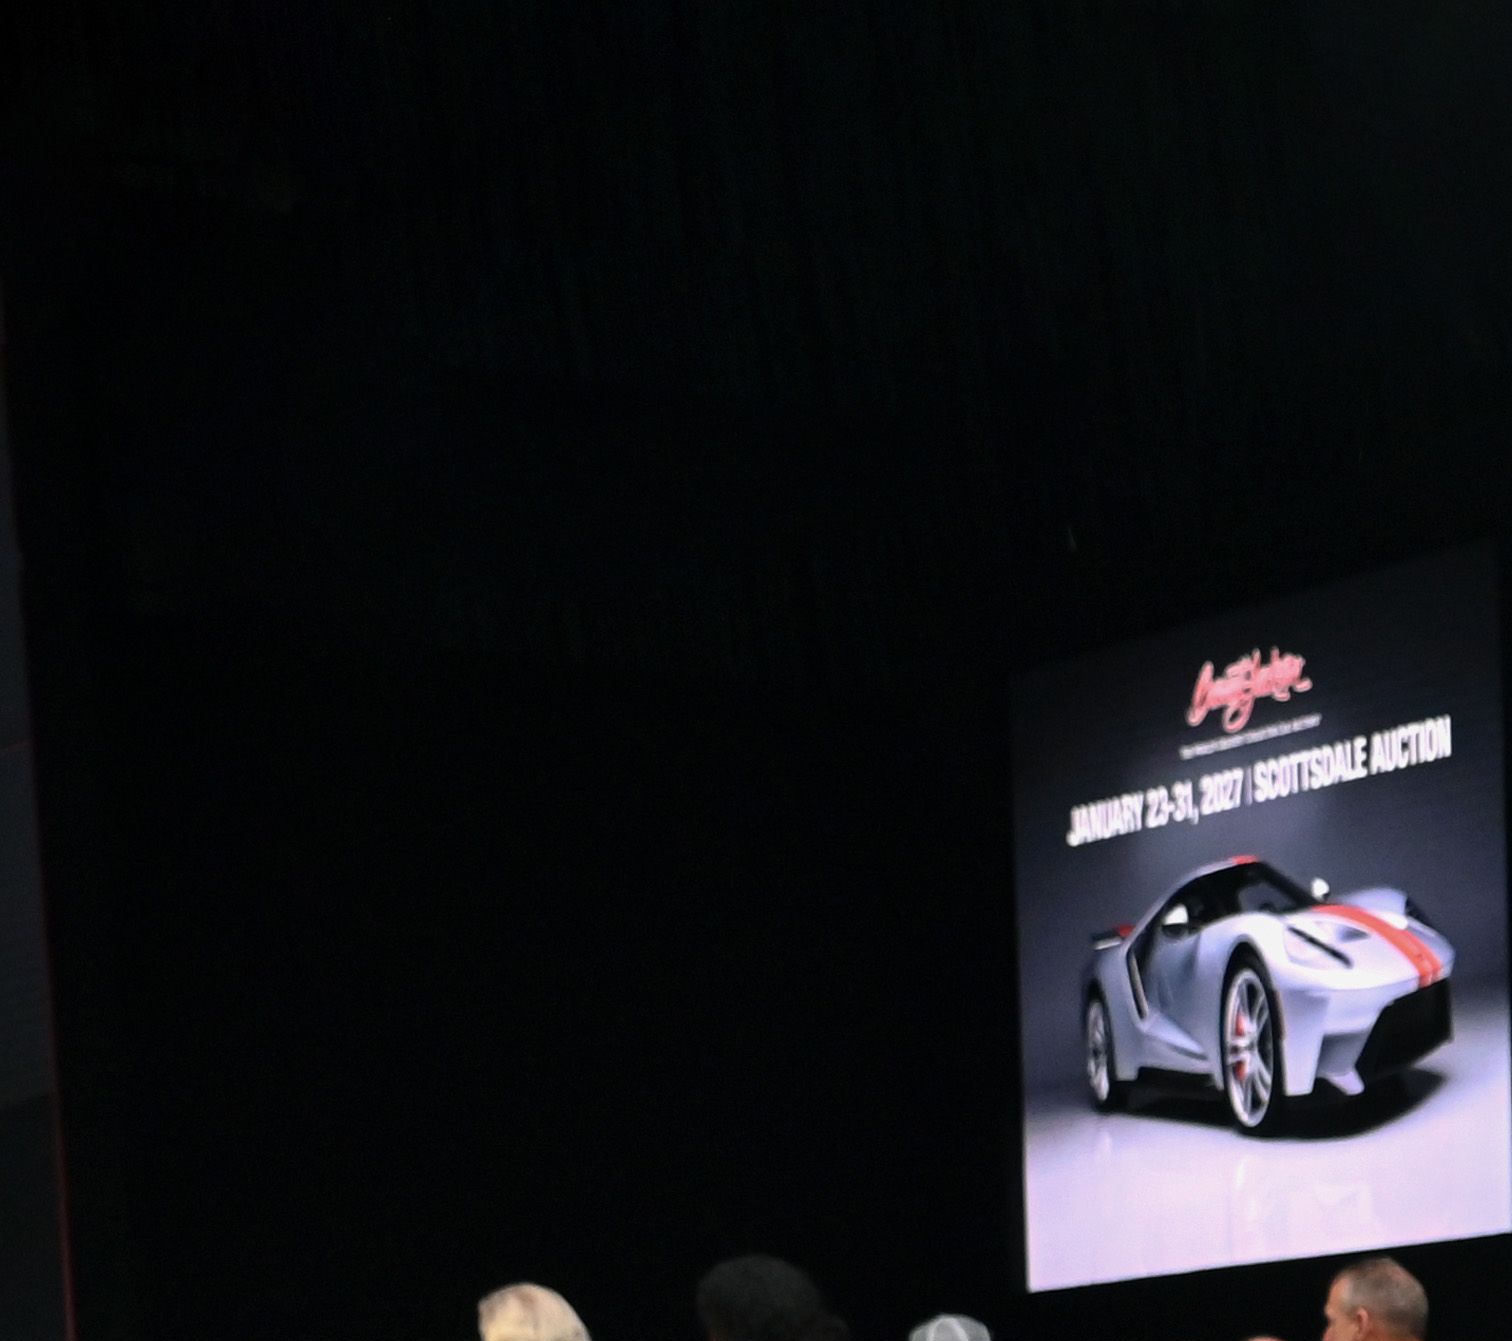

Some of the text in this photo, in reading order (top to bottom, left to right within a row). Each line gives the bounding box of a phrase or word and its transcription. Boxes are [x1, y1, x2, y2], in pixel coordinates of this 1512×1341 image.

[1066, 790, 1144, 846] JANUARY
[1145, 779, 1199, 825] 23-31,
[1200, 767, 1246, 817] 2027
[1253, 735, 1368, 803] SCOTTSDALE
[1370, 714, 1453, 775] AUCTION
